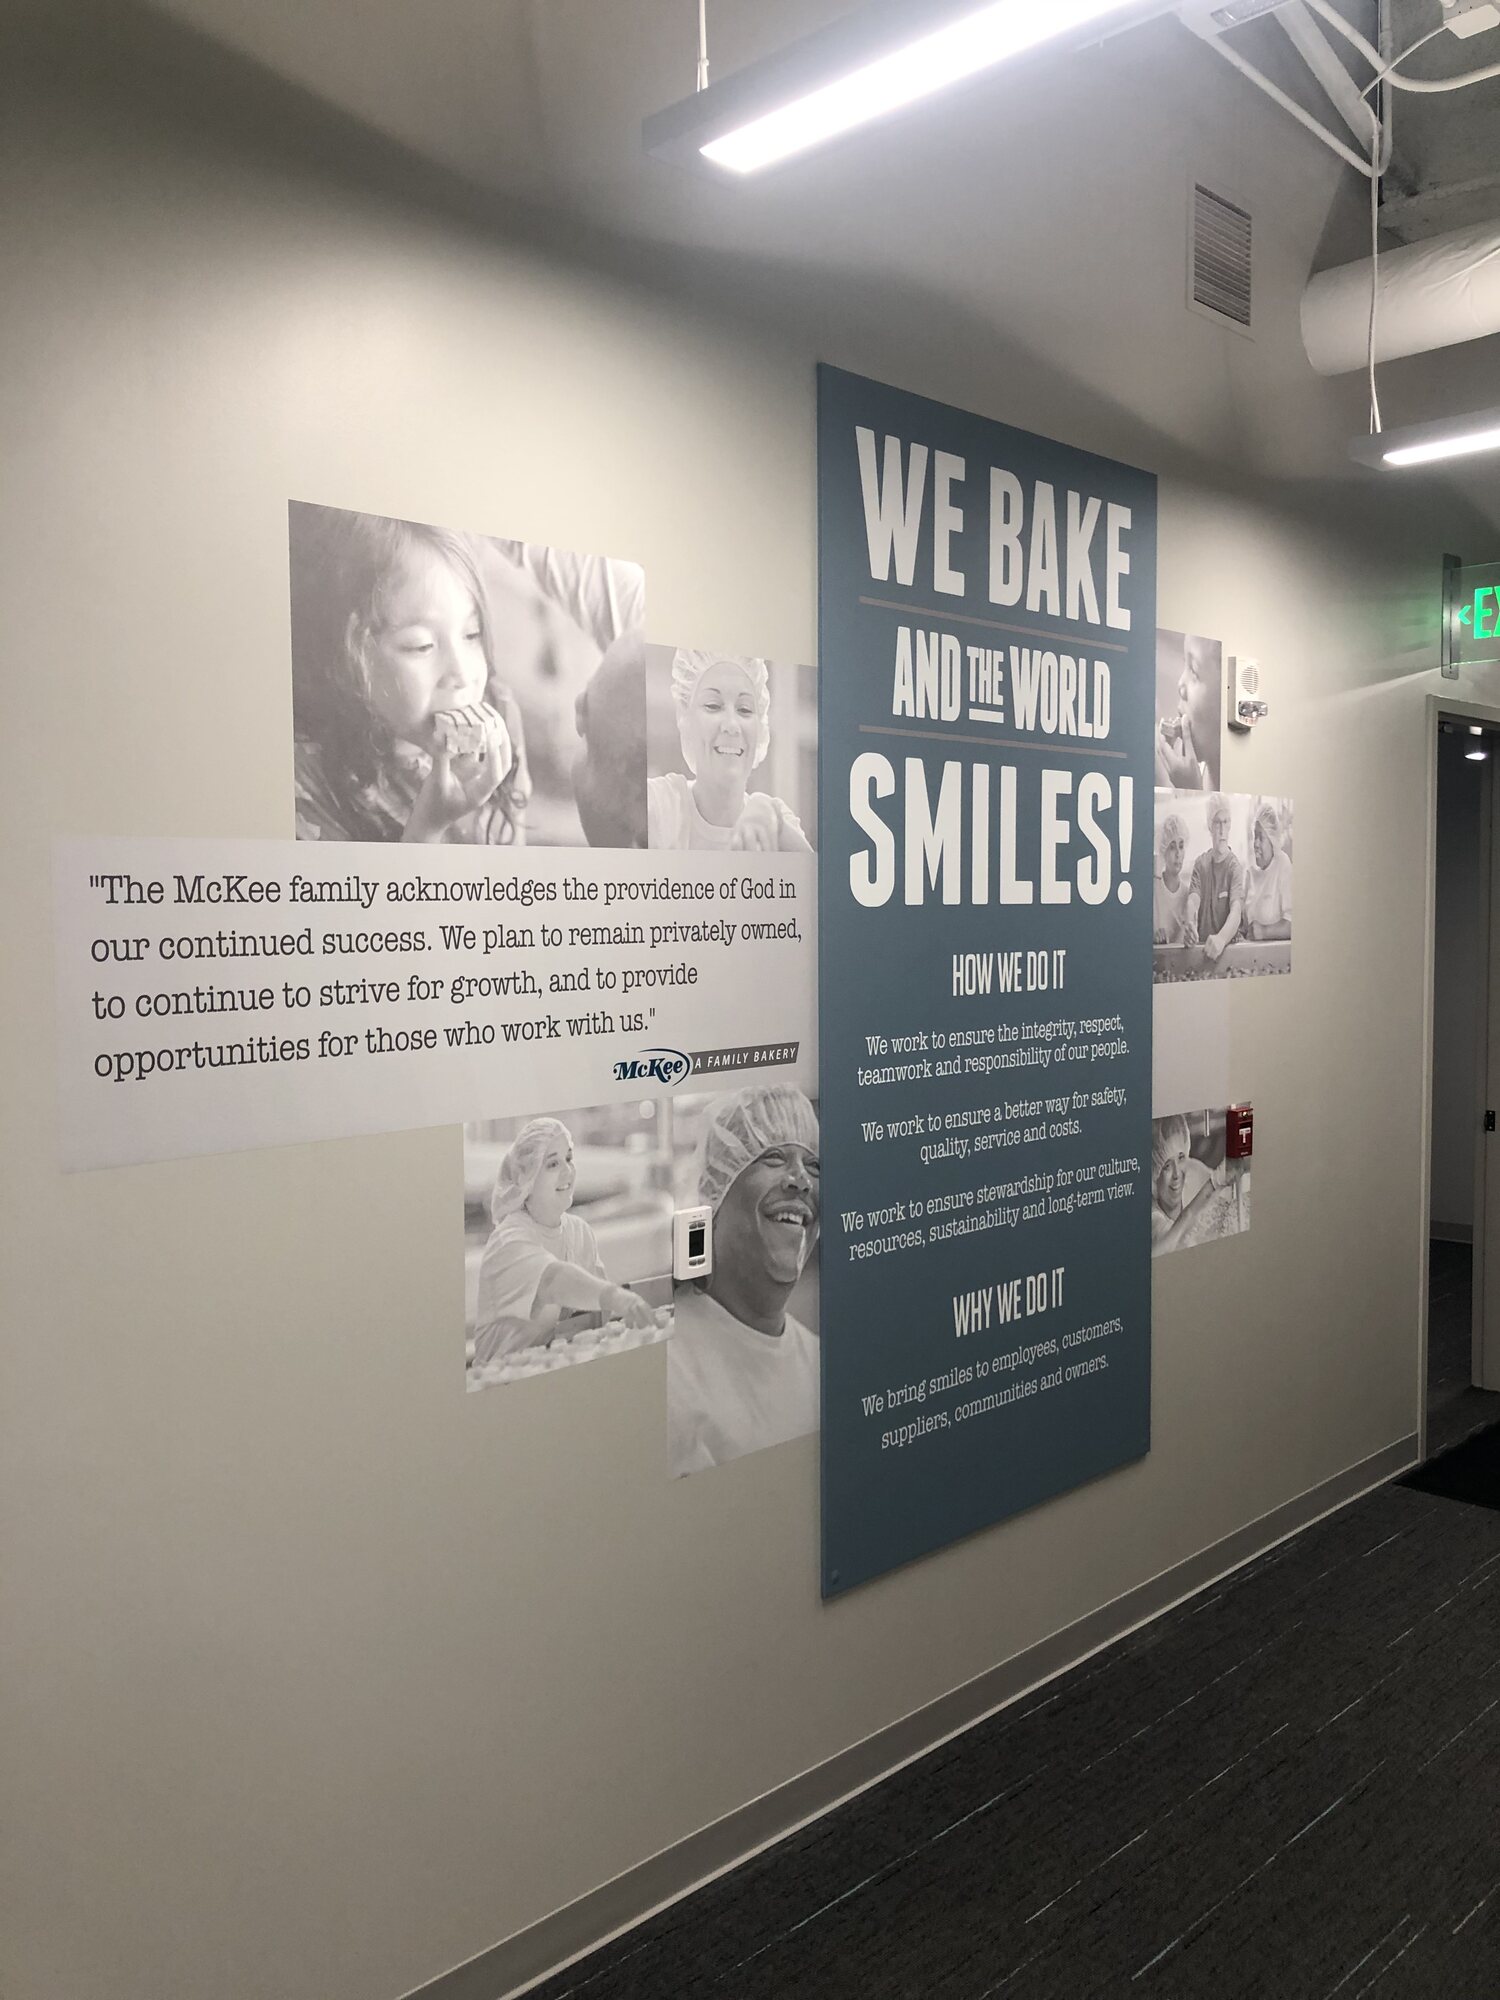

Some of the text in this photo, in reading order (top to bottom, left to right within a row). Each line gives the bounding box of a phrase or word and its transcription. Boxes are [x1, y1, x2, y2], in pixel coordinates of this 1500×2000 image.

[855, 425, 1131, 631] WE BAKE
[892, 626, 1110, 739] AND THE WORLD
[849, 752, 1134, 907] SMILES!
[90, 875, 796, 908] "The McKee family acknowledges the providence of God in
[91, 918, 802, 962] our continued success. We plan to remain privately owned,
[92, 963, 698, 1019] to continue to strive for growth, and to provide
[953, 950, 1066, 996] HOW WE DO IT
[94, 1008, 656, 1082] opportunities for those who work with us."
[613, 1048, 796, 1083] McKee A FAMILY BAKERY
[857, 1038, 1129, 1086] teamwork and responsibility of our people.
[865, 1014, 1124, 1056] We work to ensure the integrity, respect,
[861, 1085, 1127, 1142] We work to ensure a better way for safety,
[920, 1119, 1082, 1165] quality, service and costs.
[841, 1156, 1140, 1233] We work to ensure stewardship for our culture,
[849, 1182, 1134, 1261] resources, sustainability and long-term view.
[953, 1267, 1065, 1337] WHY WE DO IT
[862, 1317, 1123, 1416] We bring smiles to employees, customers,
[882, 1354, 1109, 1449] suppliers, communities and owners.
